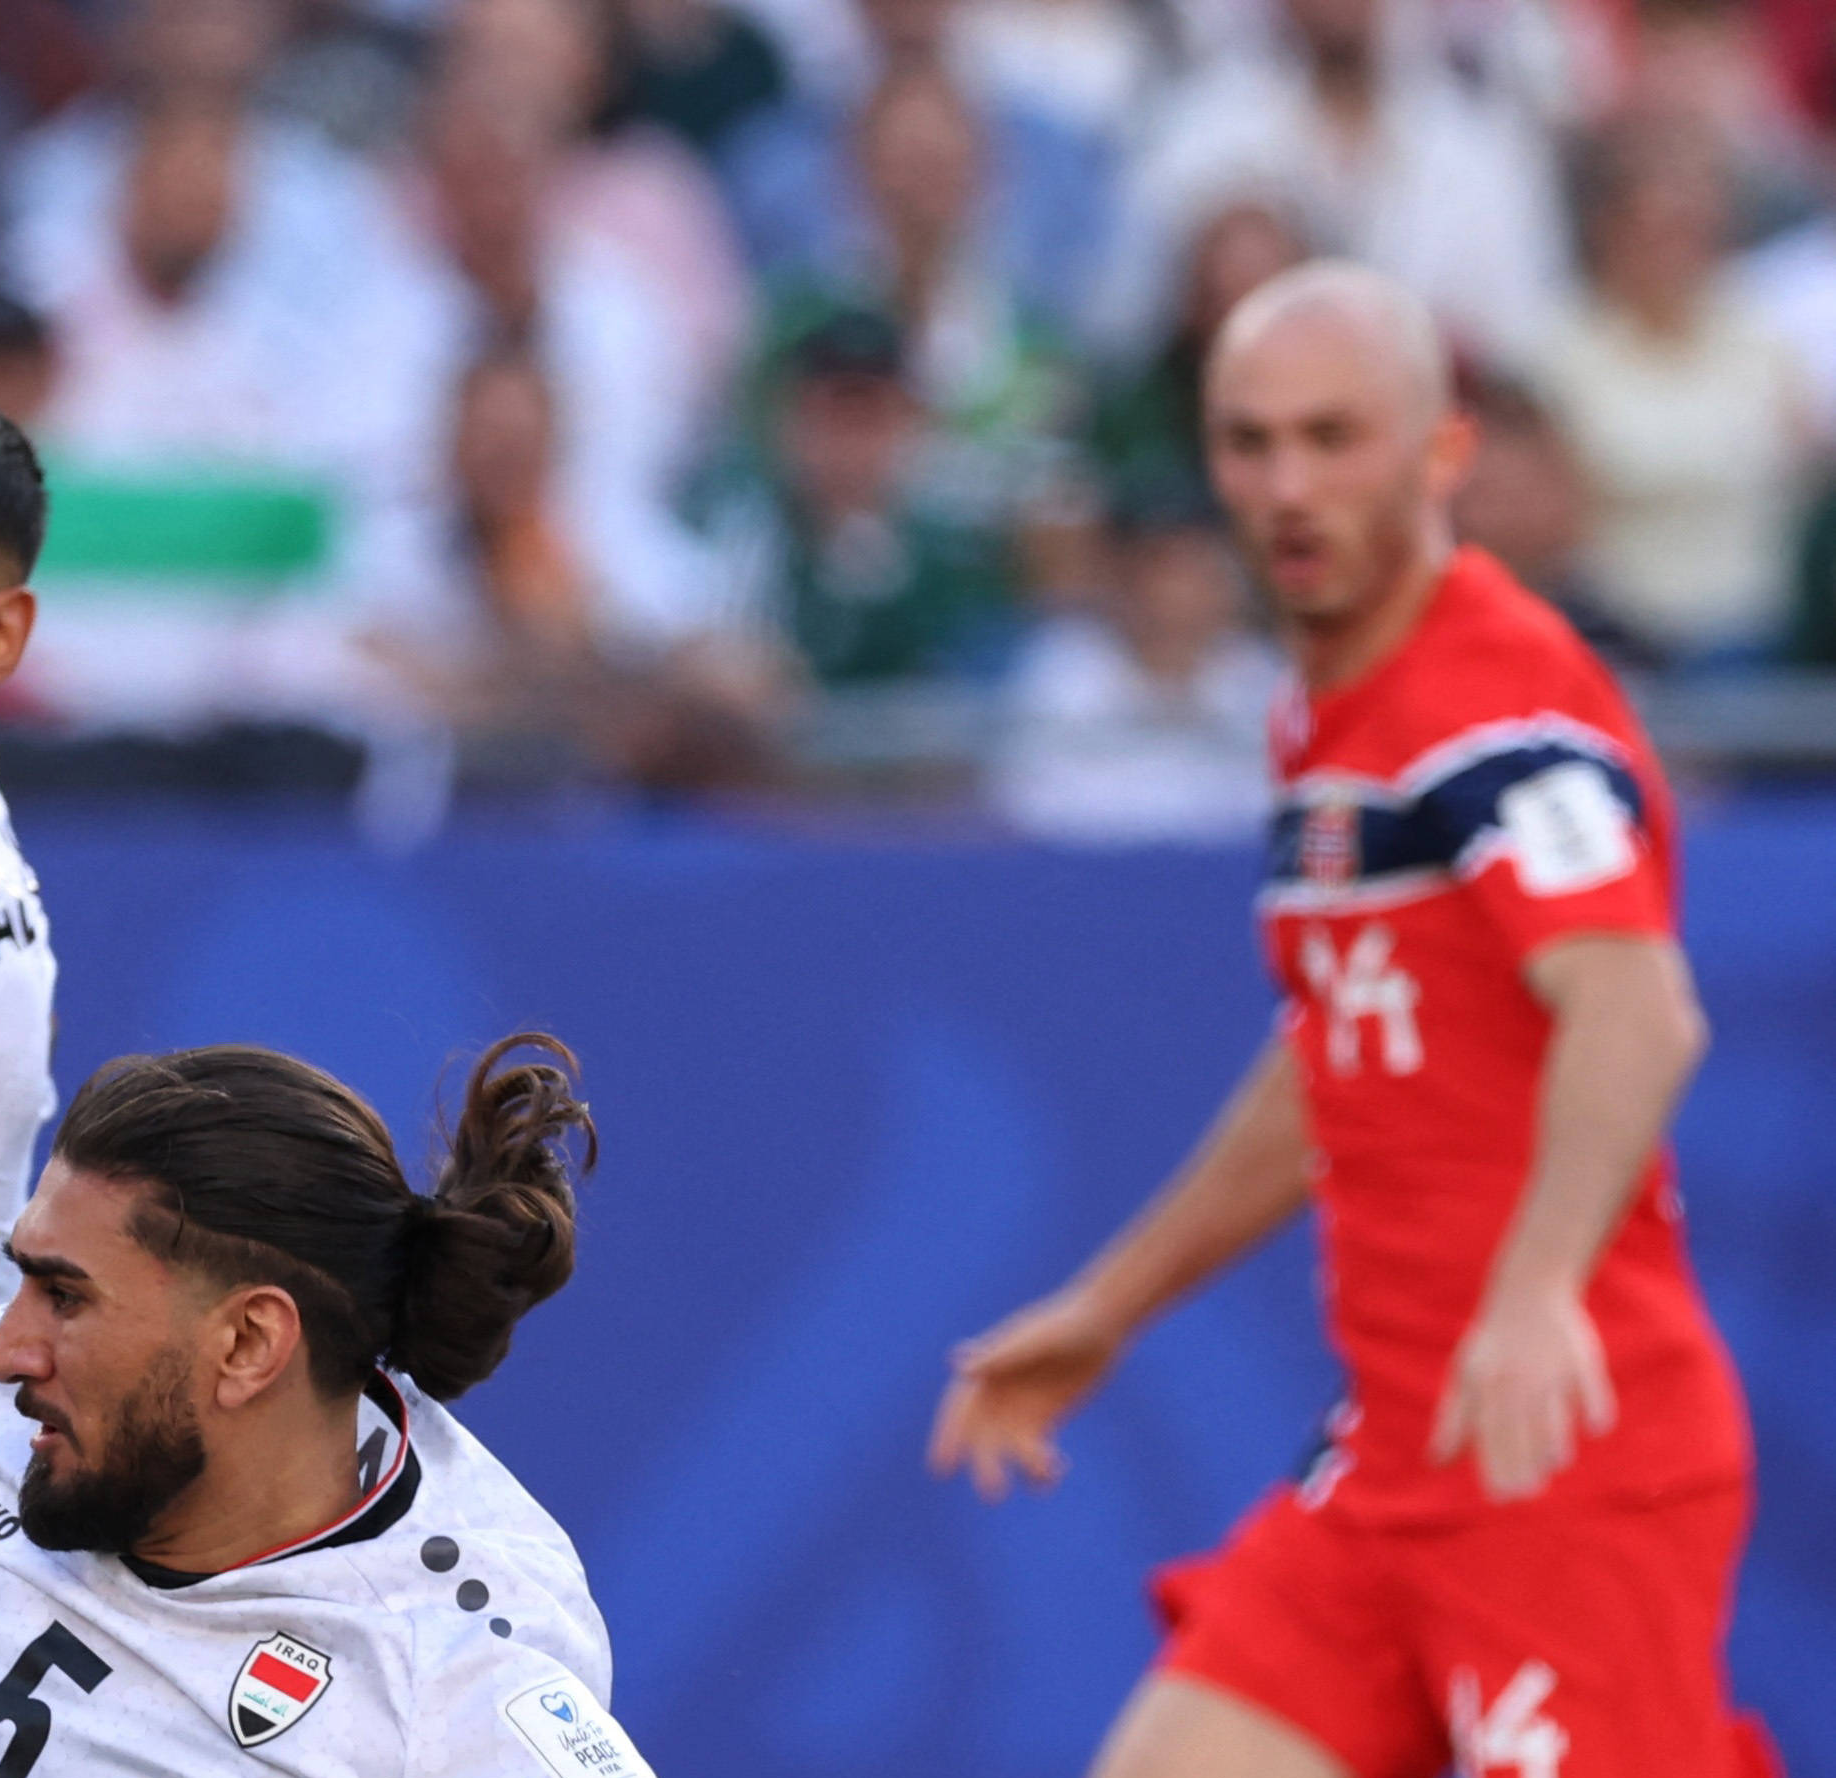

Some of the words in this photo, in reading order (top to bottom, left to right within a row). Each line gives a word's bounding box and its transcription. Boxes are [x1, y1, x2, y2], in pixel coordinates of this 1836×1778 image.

[1299, 918, 1426, 1078] 14
[275, 1641, 320, 1672] IRAQ
[574, 1739, 621, 1769] PEACE
